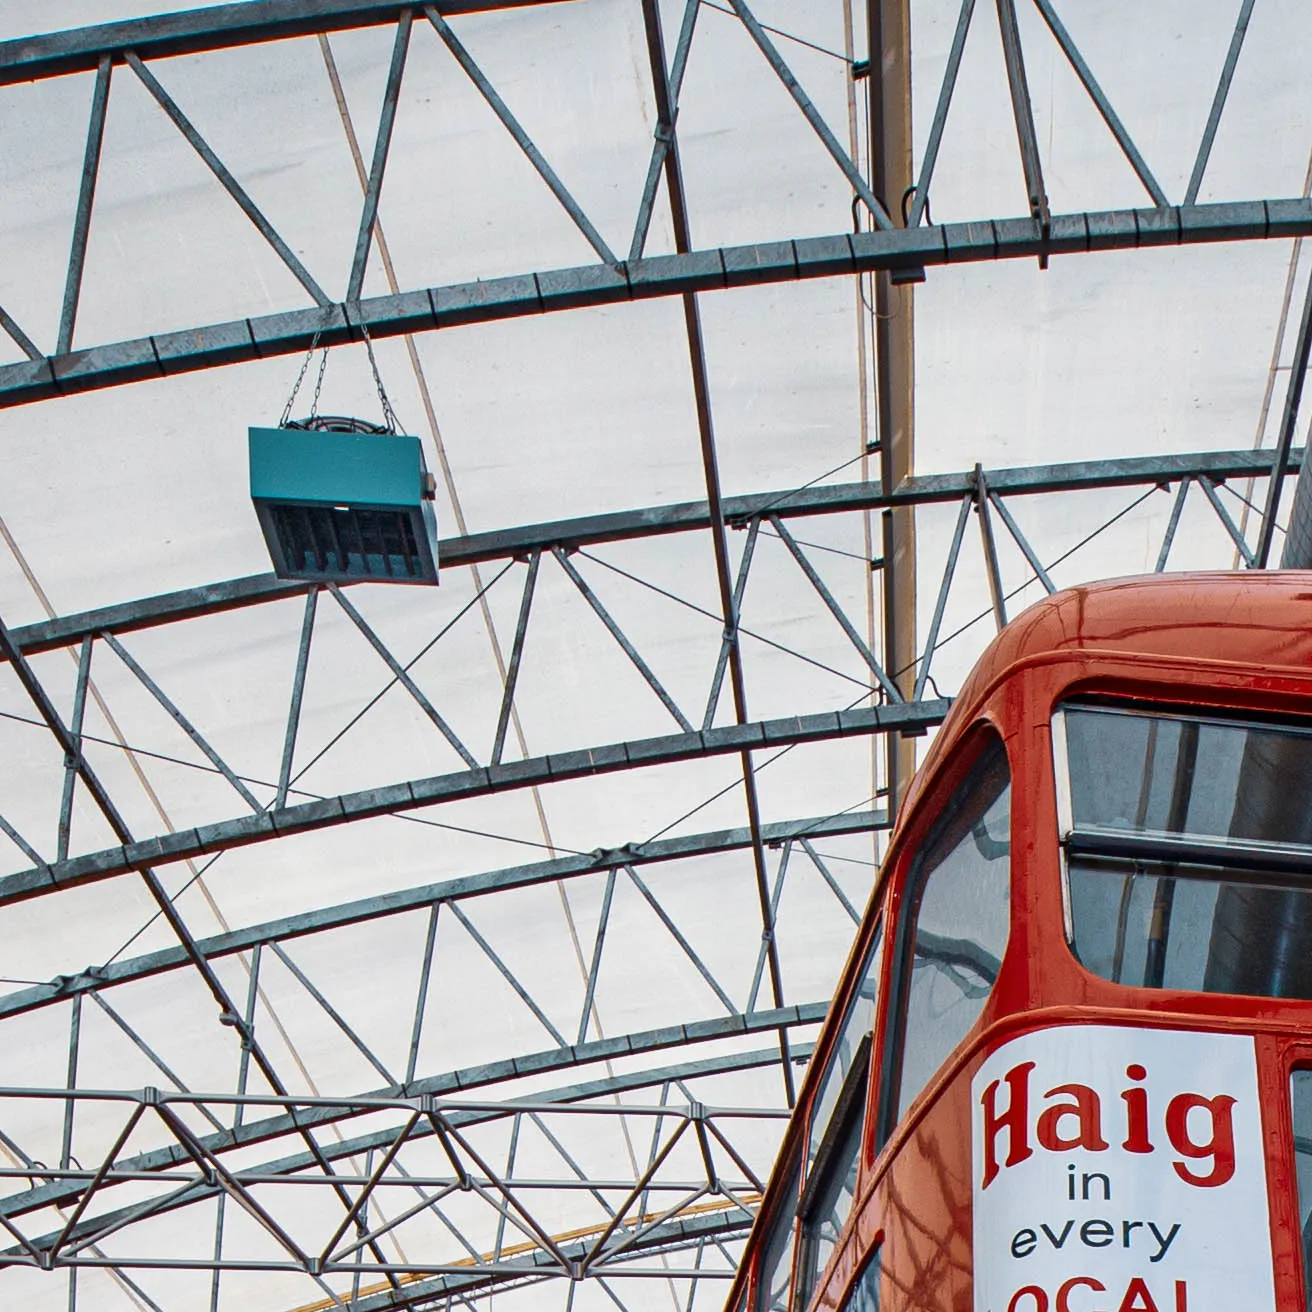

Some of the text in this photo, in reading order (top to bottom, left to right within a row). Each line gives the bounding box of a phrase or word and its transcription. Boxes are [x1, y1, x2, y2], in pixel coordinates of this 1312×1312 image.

[980, 1061, 1238, 1190] Haig
[1067, 1164, 1110, 1200] in
[1010, 1219, 1181, 1262] every
